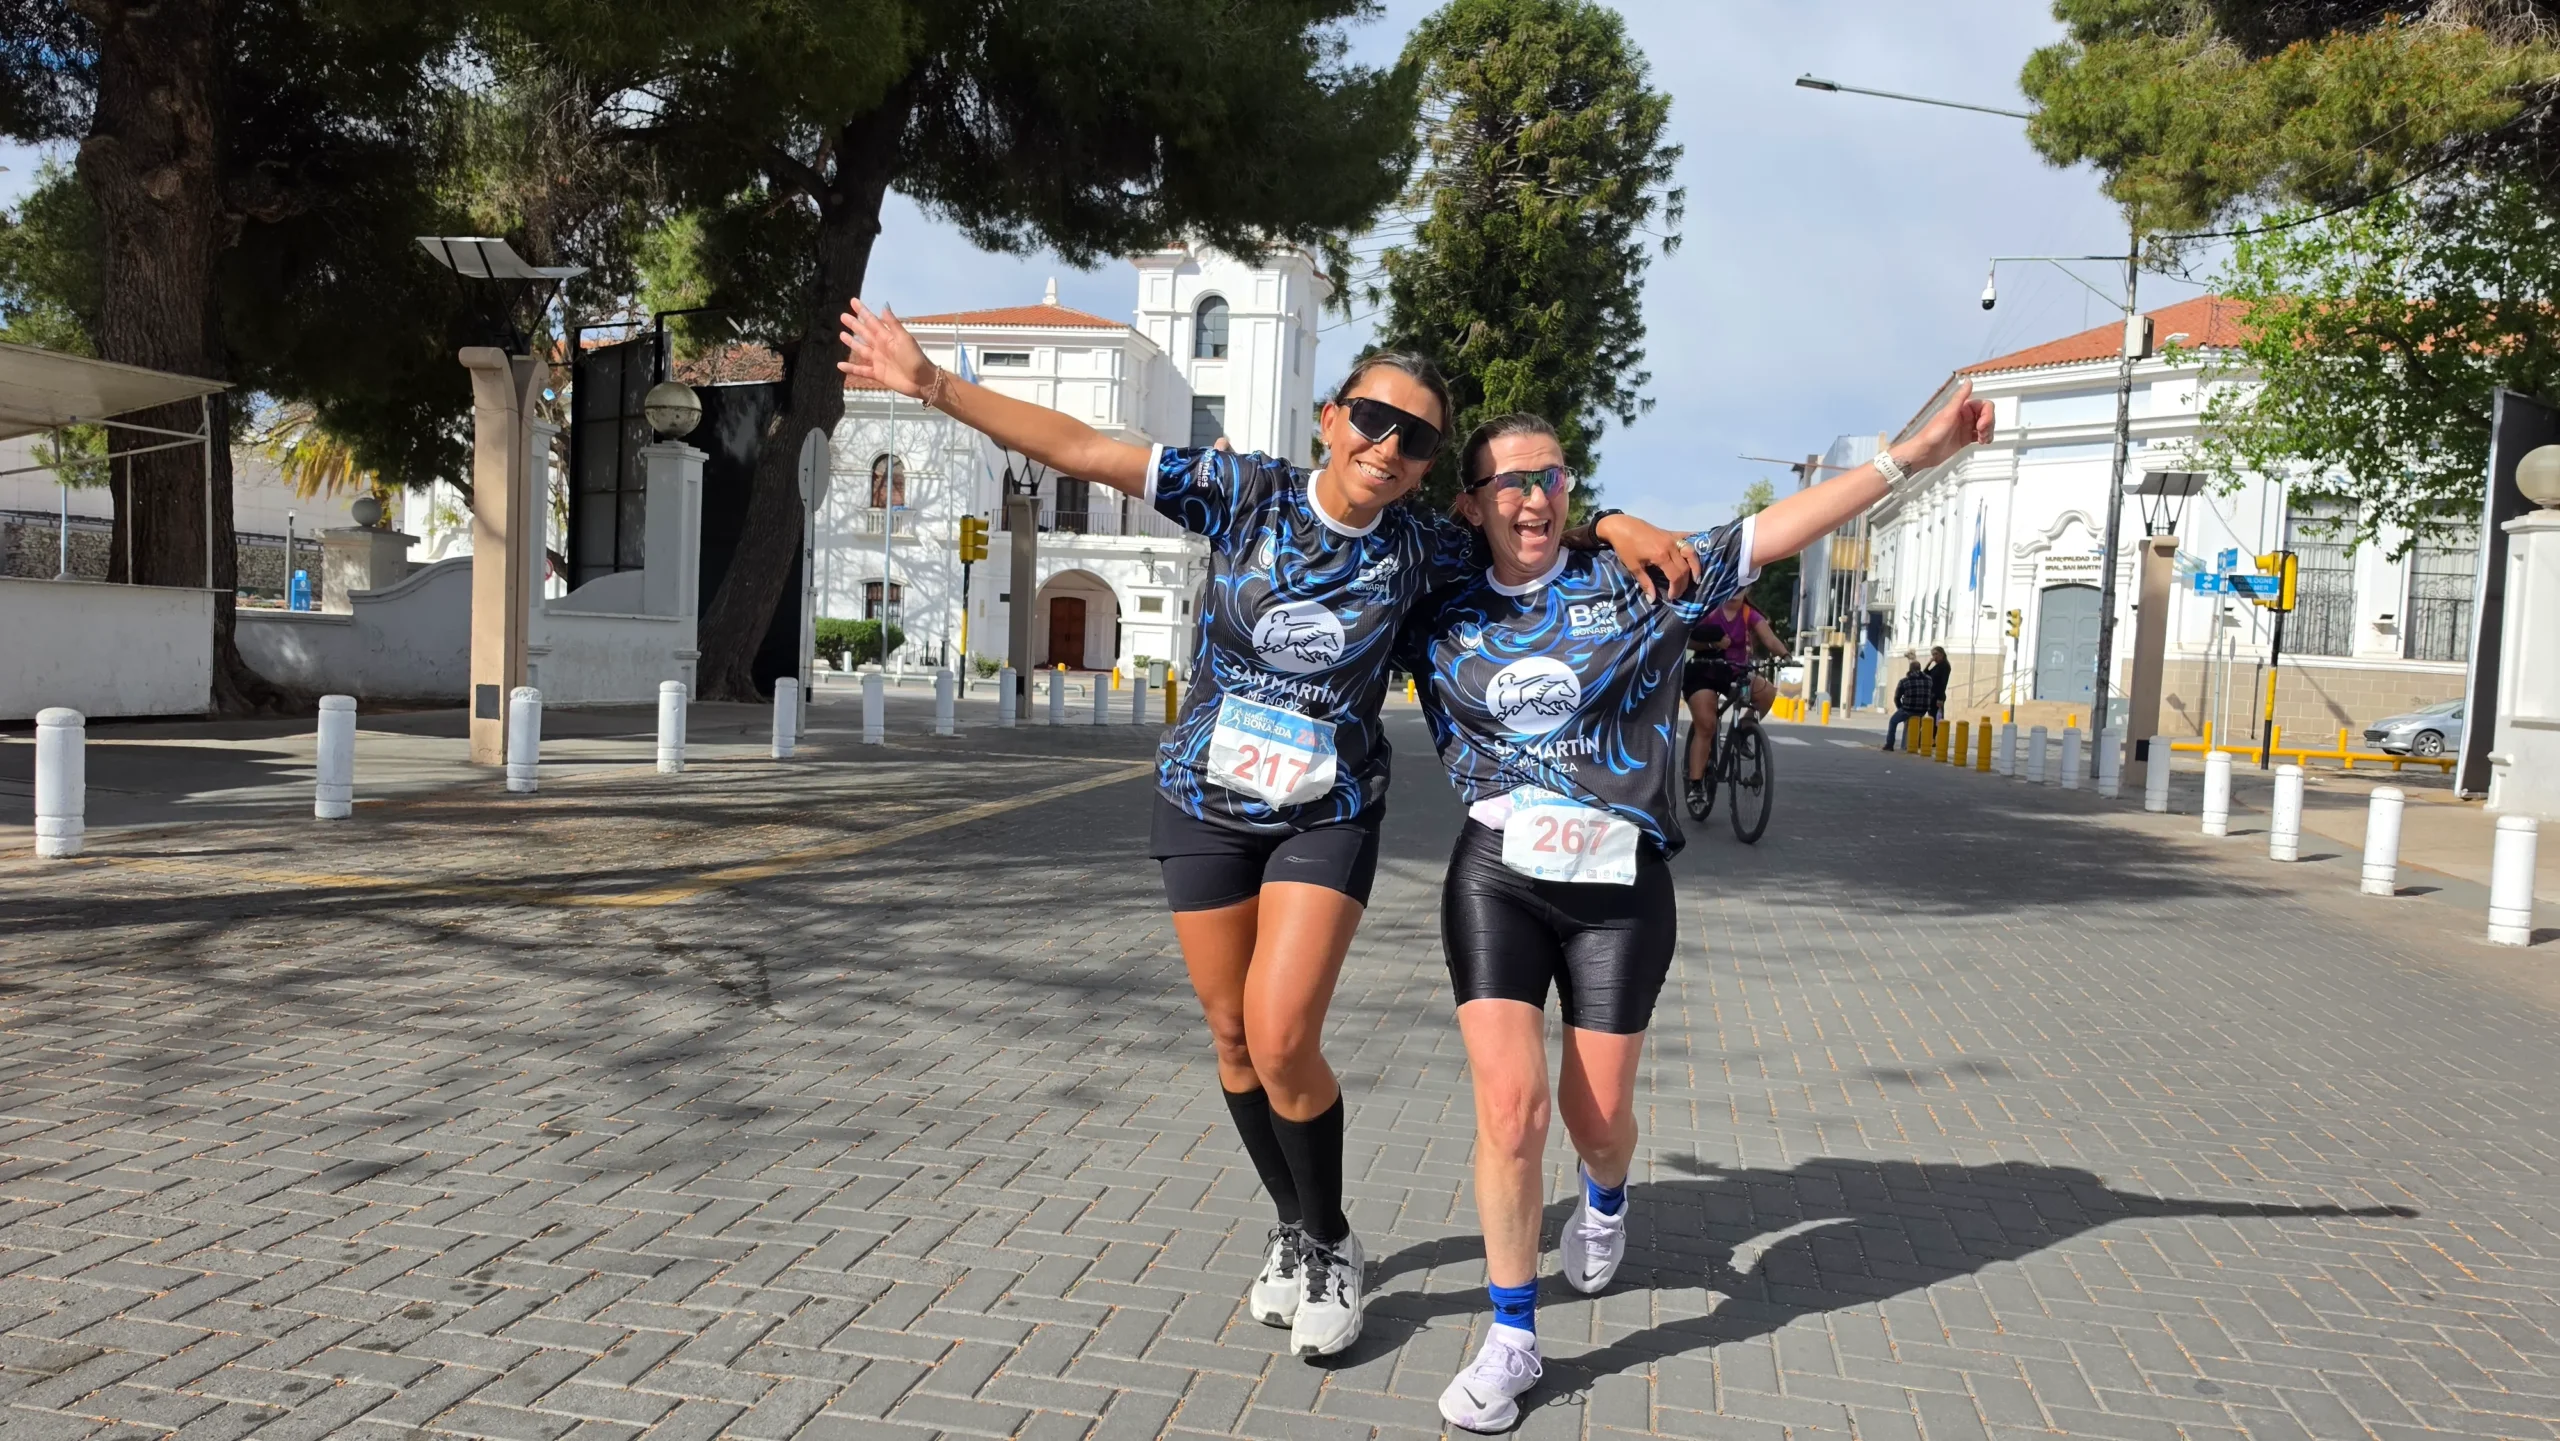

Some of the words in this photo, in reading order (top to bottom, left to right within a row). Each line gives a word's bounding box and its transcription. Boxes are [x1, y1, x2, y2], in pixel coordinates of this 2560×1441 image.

[2234, 575, 2273, 584] BOULOGNE
[2253, 583, 2269, 591] MER
[1230, 665, 1267, 687] SAN
[1270, 674, 1341, 704] MARTÍN
[1247, 690, 1311, 715] MENDOZA
[1243, 716, 1293, 739] BONARDA
[1525, 734, 1600, 760] MARTÍN
[1232, 744, 1311, 793] 217
[1532, 815, 1611, 856] 267
